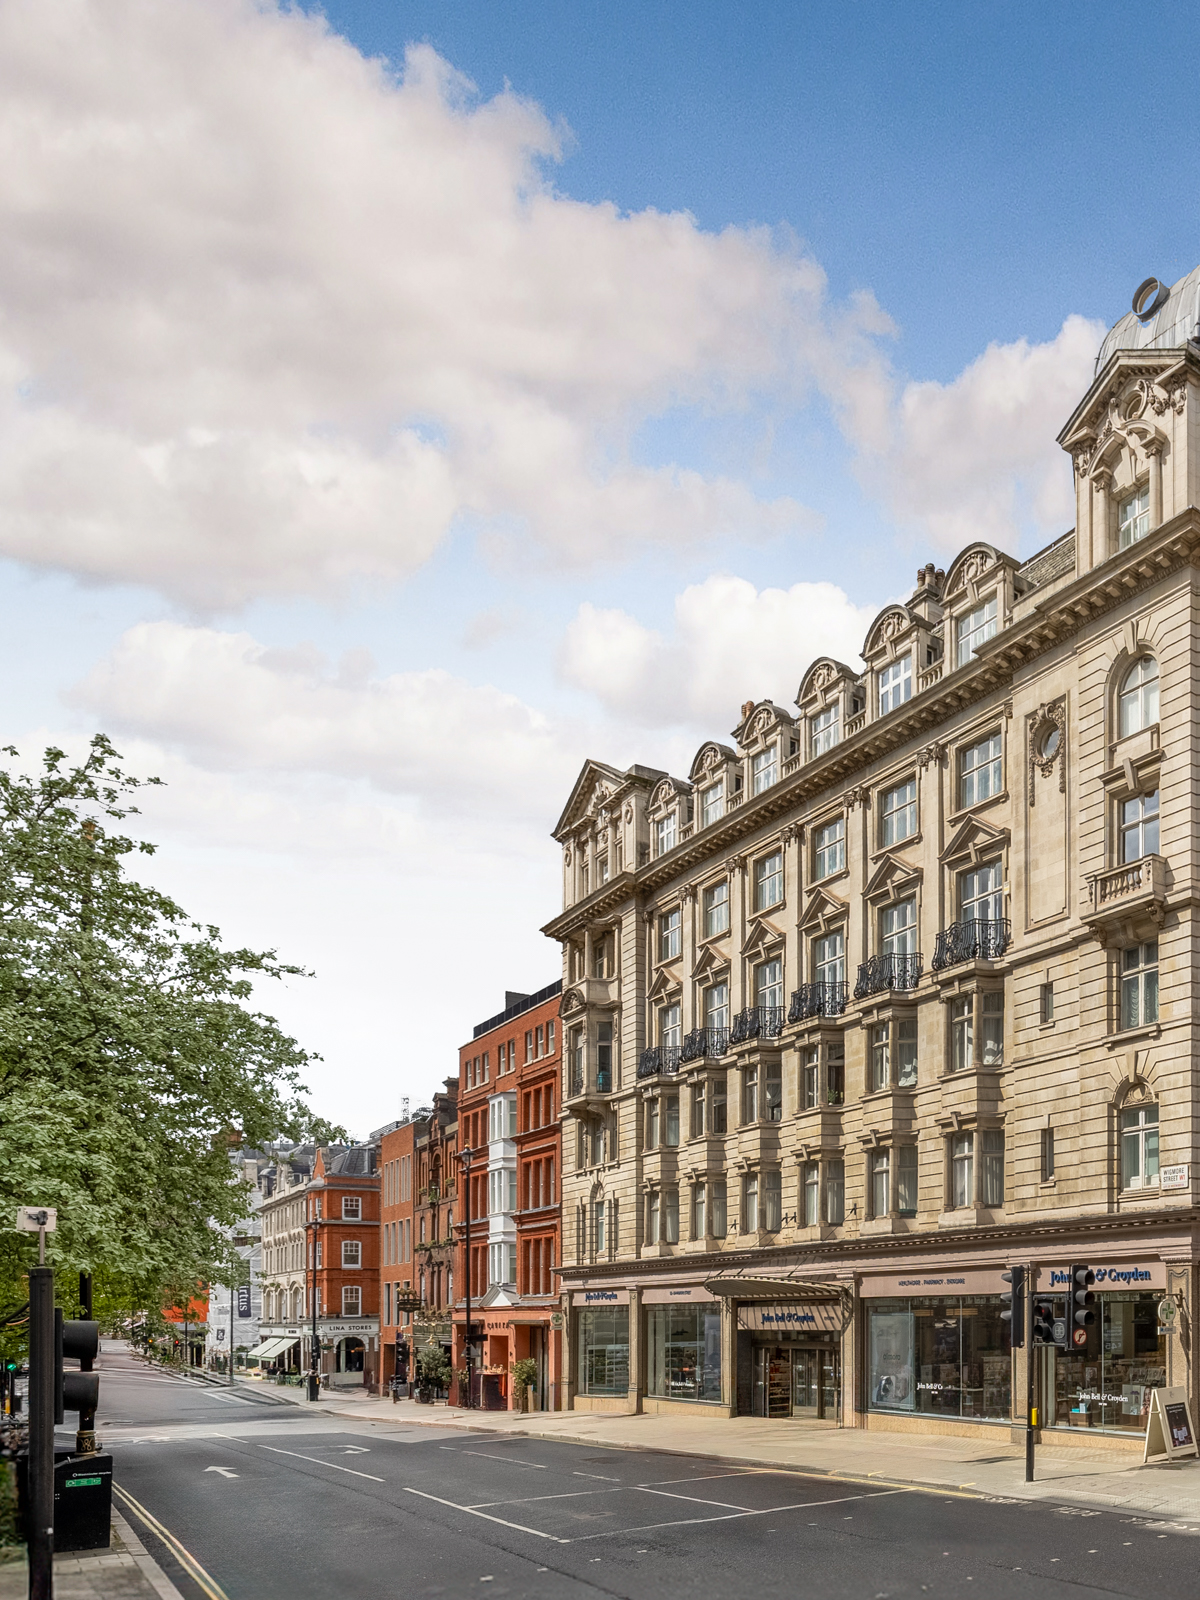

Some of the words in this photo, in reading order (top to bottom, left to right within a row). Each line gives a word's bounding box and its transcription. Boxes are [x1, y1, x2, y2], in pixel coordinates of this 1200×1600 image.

[1163, 1167, 1185, 1176] WIGMORE
[1163, 1175, 1178, 1183] STREET
[1095, 1268, 1107, 1281] &
[1107, 1267, 1152, 1285] Croyden
[239, 1285, 249, 1311] irtus
[1078, 1392, 1091, 1401] John
[1091, 1392, 1100, 1400] Bell
[1101, 1393, 1107, 1401] &
[1107, 1393, 1129, 1403] Croyden
